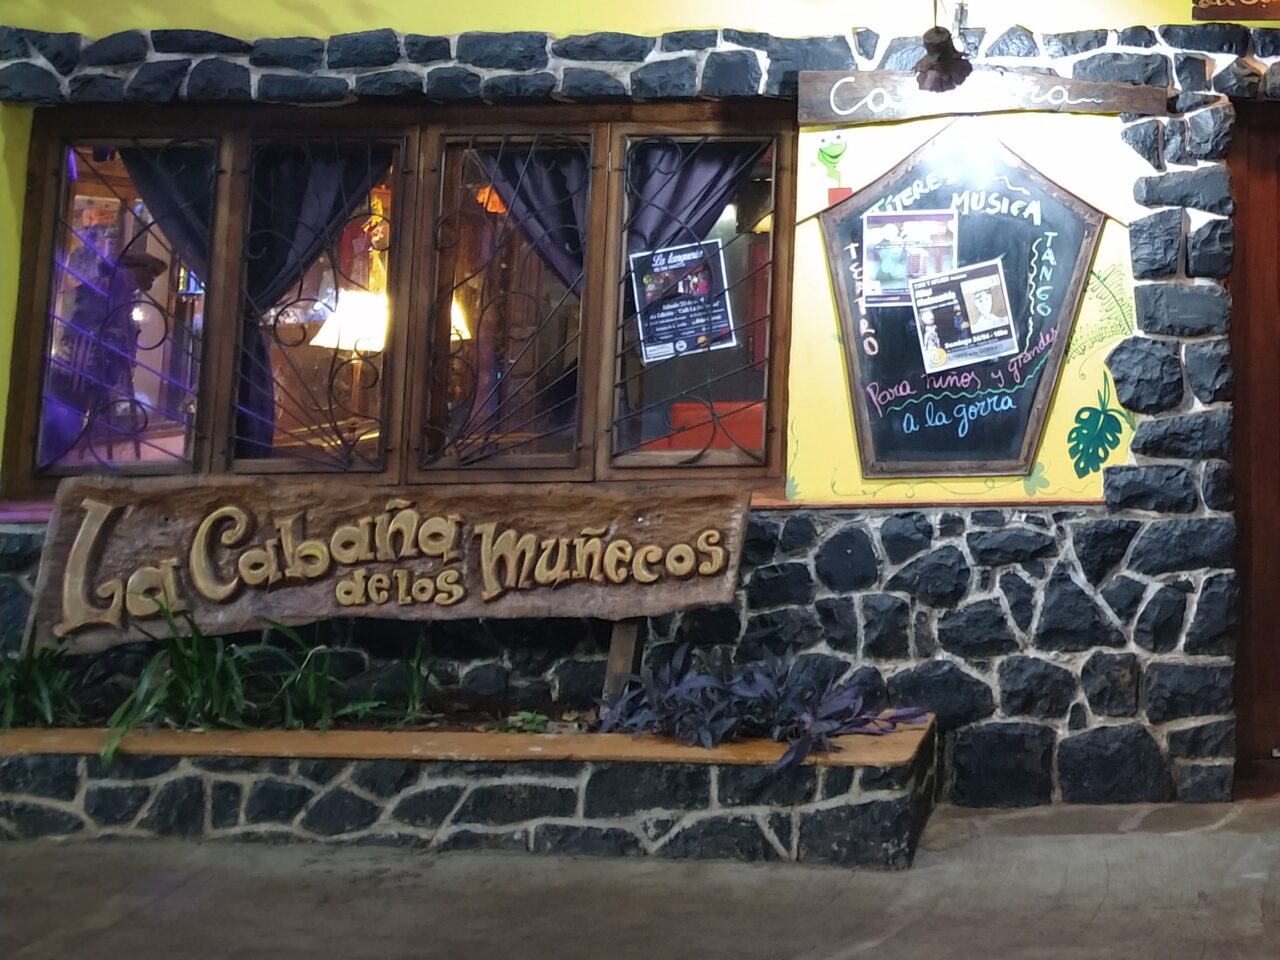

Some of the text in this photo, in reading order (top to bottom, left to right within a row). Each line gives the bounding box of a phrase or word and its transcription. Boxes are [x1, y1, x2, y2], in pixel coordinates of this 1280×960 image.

[1036, 231, 1059, 316] TANGO
[866, 381, 917, 418] Para
[921, 371, 981, 390] niños
[991, 370, 1004, 387] y
[1008, 328, 1058, 383] grandes
[903, 394, 1017, 438] a la gorra
[54, 498, 460, 636] La Cabaña
[475, 520, 727, 602] Muñecos
